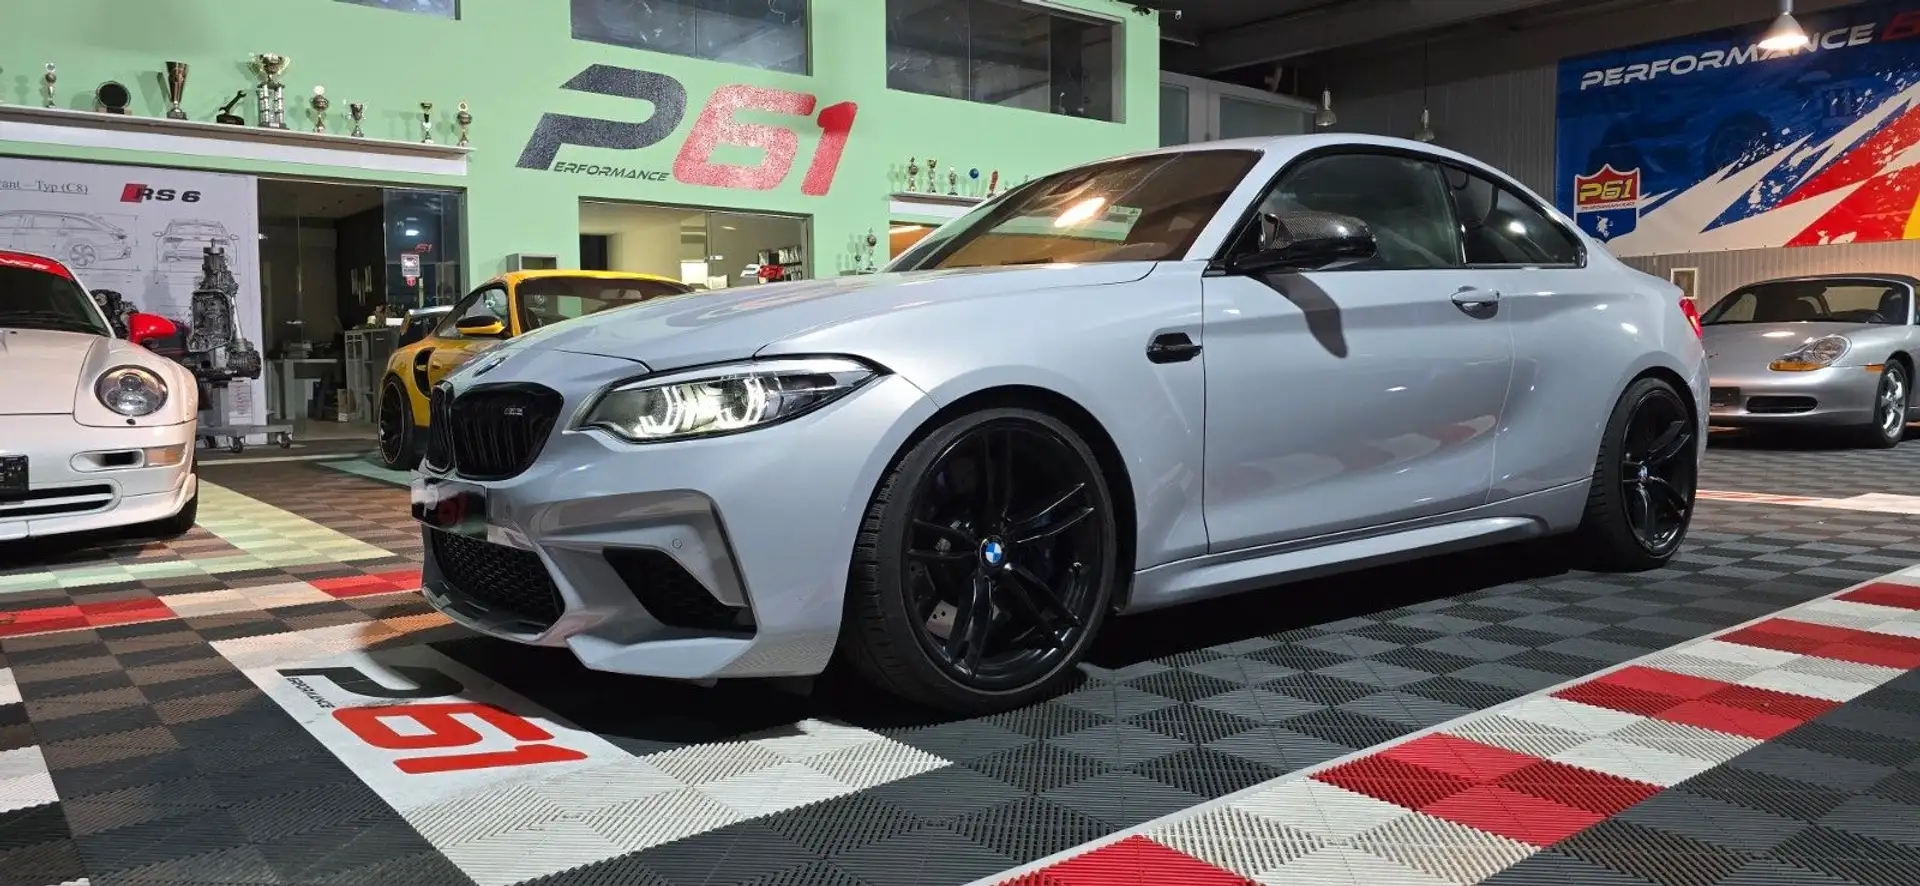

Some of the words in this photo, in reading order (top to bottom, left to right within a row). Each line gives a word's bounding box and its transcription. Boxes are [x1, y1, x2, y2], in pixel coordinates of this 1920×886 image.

[515, 63, 858, 196] P61
[0, 179, 20, 189] ant
[35, 179, 58, 193] Typ
[61, 181, 89, 195] (C8)
[135, 186, 176, 202] RS
[181, 189, 202, 203] 6
[1579, 178, 1633, 202] P61
[275, 665, 588, 775] P61
